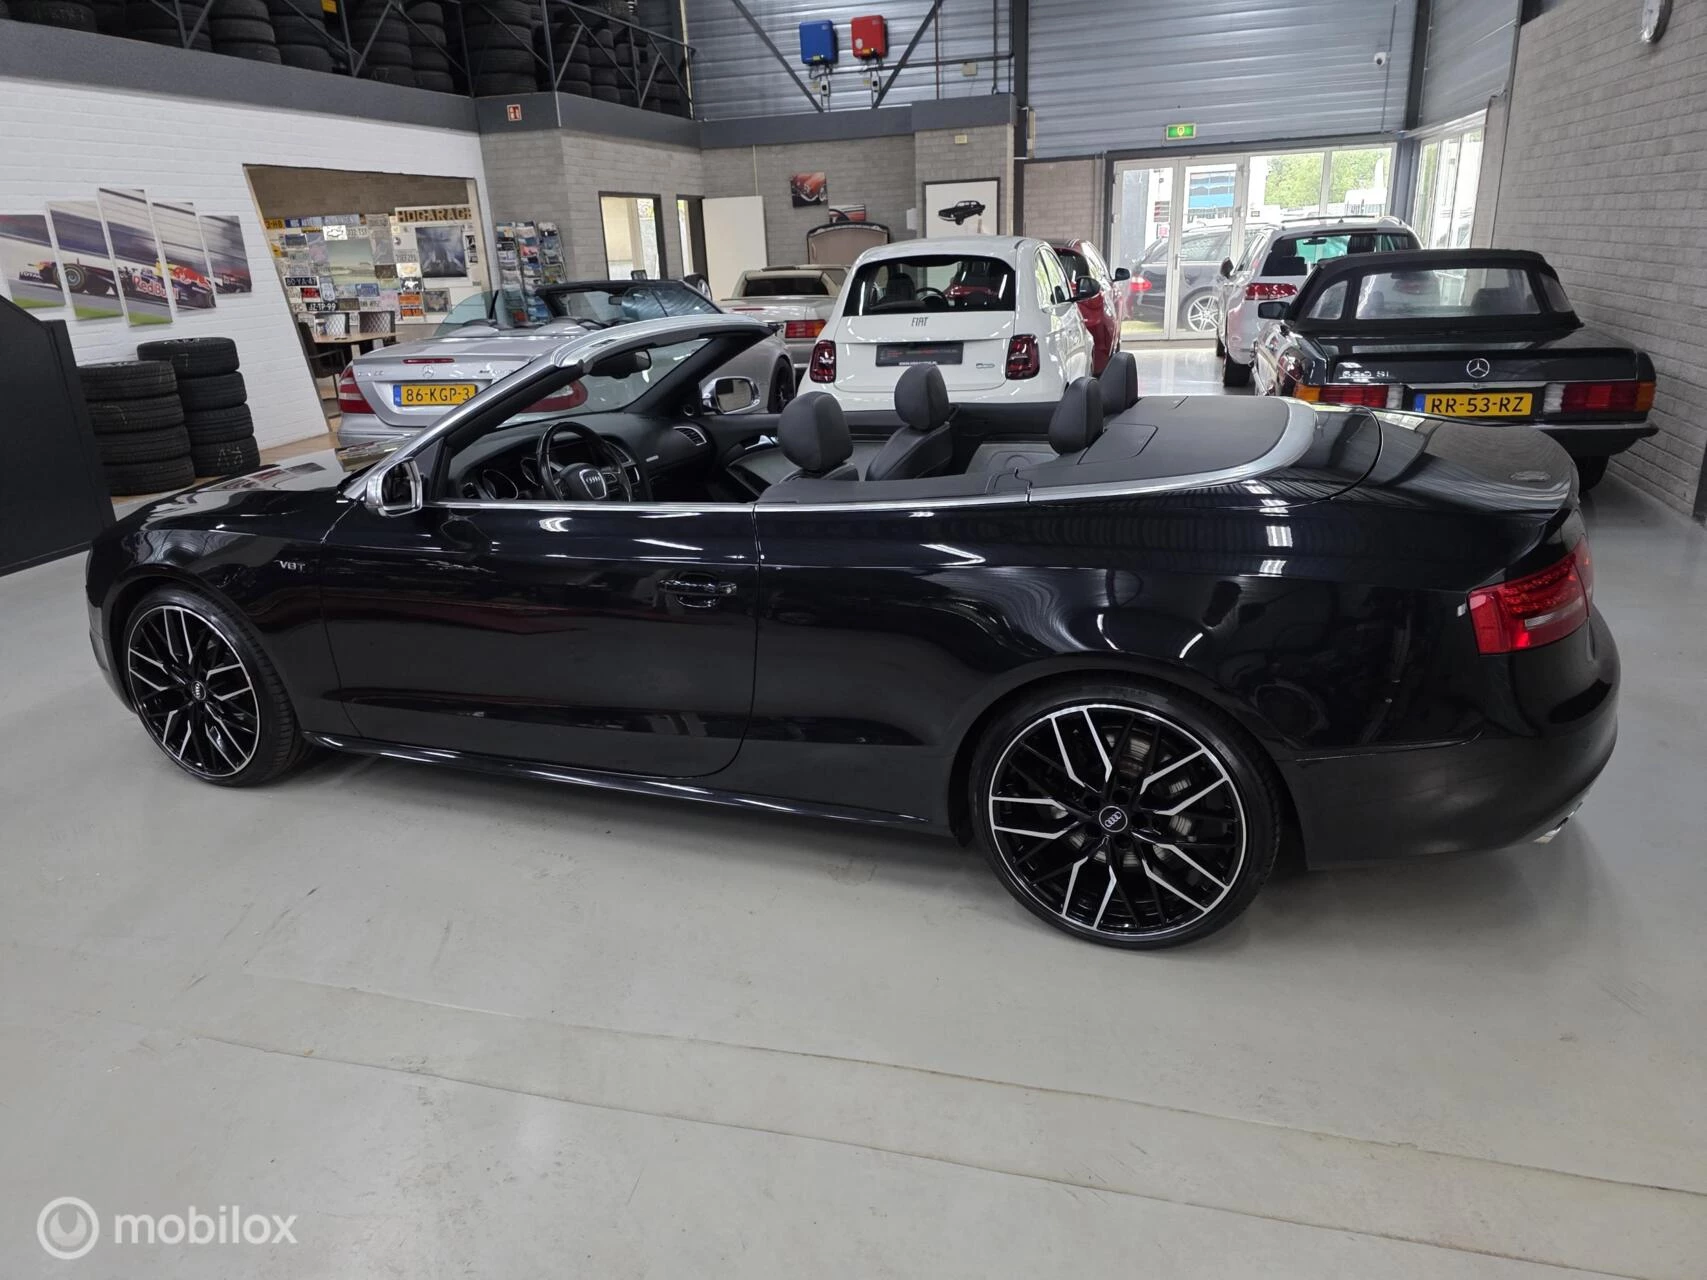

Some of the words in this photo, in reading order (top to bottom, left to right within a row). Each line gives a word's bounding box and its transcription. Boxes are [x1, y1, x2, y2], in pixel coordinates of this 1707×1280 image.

[911, 317, 929, 327] FIAT
[406, 387, 471, 402] 86-KGP-3
[1431, 396, 1525, 413] RR-53-RZ
